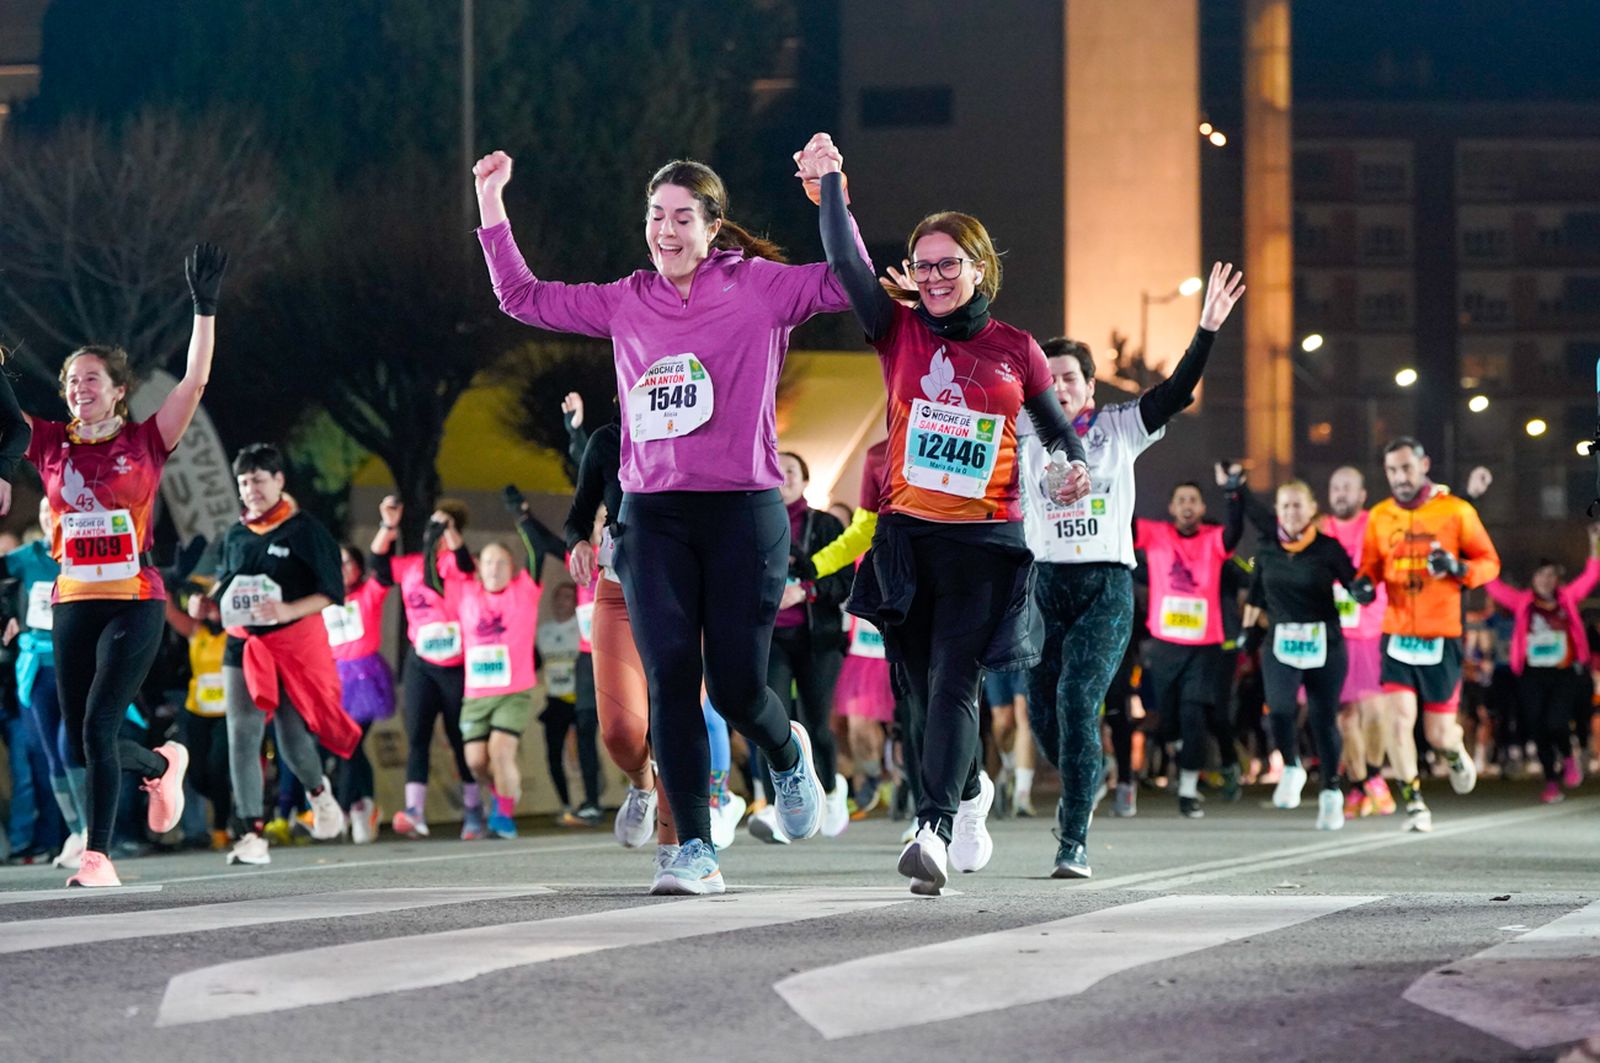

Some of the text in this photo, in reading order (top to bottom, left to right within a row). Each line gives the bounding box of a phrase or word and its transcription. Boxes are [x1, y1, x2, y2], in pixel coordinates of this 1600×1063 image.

[648, 365, 674, 376] NOCHE
[648, 383, 697, 411] 1548
[918, 420, 937, 431] SAN
[931, 411, 958, 425] NOCHE
[959, 417, 971, 427] DE
[917, 432, 987, 469] 12446
[75, 493, 94, 512] 43
[1054, 518, 1098, 539] 1550
[75, 536, 121, 558] 9709
